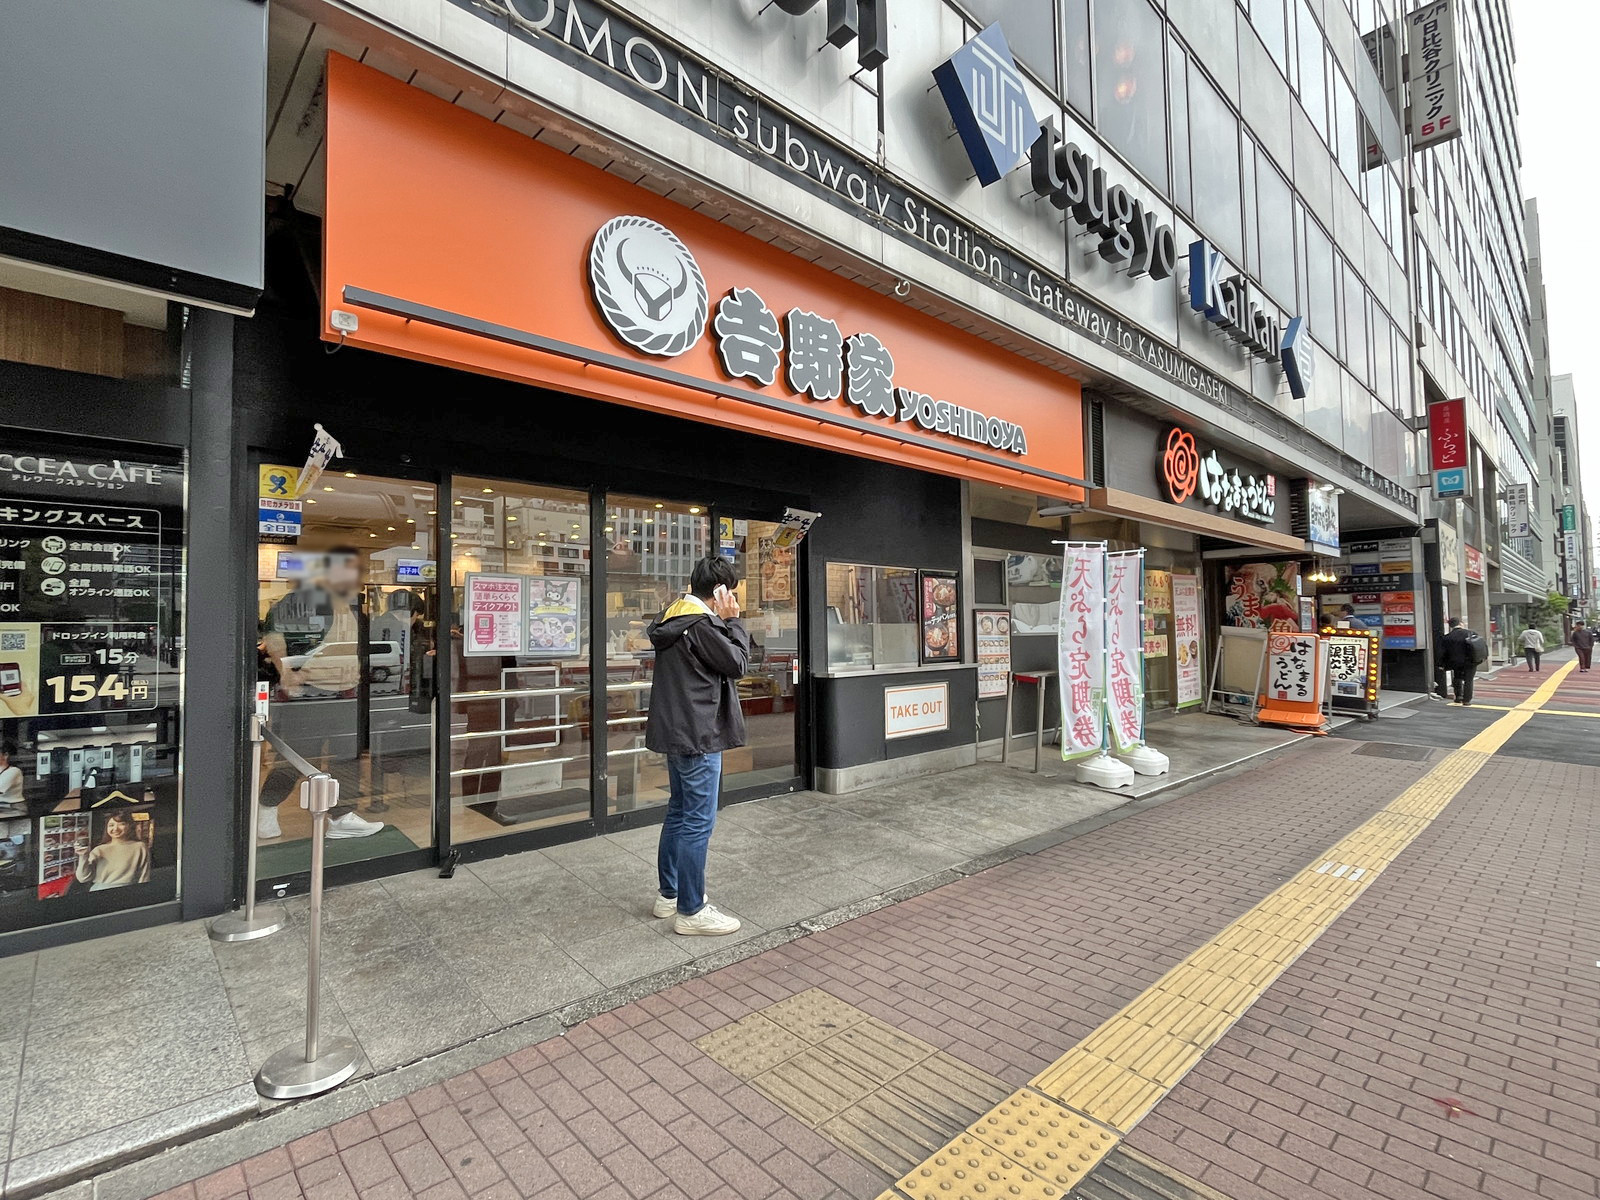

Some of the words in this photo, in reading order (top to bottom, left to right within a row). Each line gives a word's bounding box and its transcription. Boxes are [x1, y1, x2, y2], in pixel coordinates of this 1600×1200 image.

[1421, 19, 1445, 120] 日比谷クリニック
[1032, 115, 1178, 281] tsugyo
[1190, 239, 1282, 364] Kaikan
[903, 197, 1003, 283] Station
[1027, 269, 1111, 345] Gateway
[1116, 321, 1134, 352] to
[1138, 334, 1228, 405] KASUMIGASEKI
[714, 287, 896, 418] 吉野家
[897, 387, 1028, 456] YOSHINOYA
[12, 474, 125, 490] テレワークステーション
[87, 461, 162, 486] CAFÉ
[1200, 449, 1275, 516] はなまるうどん
[69, 578, 91, 588] 全席
[69, 588, 150, 597] オンライン通話OK
[473, 582, 518, 591] スマホ注文で
[474, 592, 517, 601] 簡単らくらく
[474, 602, 518, 611] テイクアウト
[95, 648, 140, 665] 15分
[1290, 640, 1312, 697] はなまる
[1273, 656, 1293, 690] うどん
[46, 674, 148, 703] 154円
[890, 703, 919, 719] TAKE
[921, 700, 943, 715] OUT
